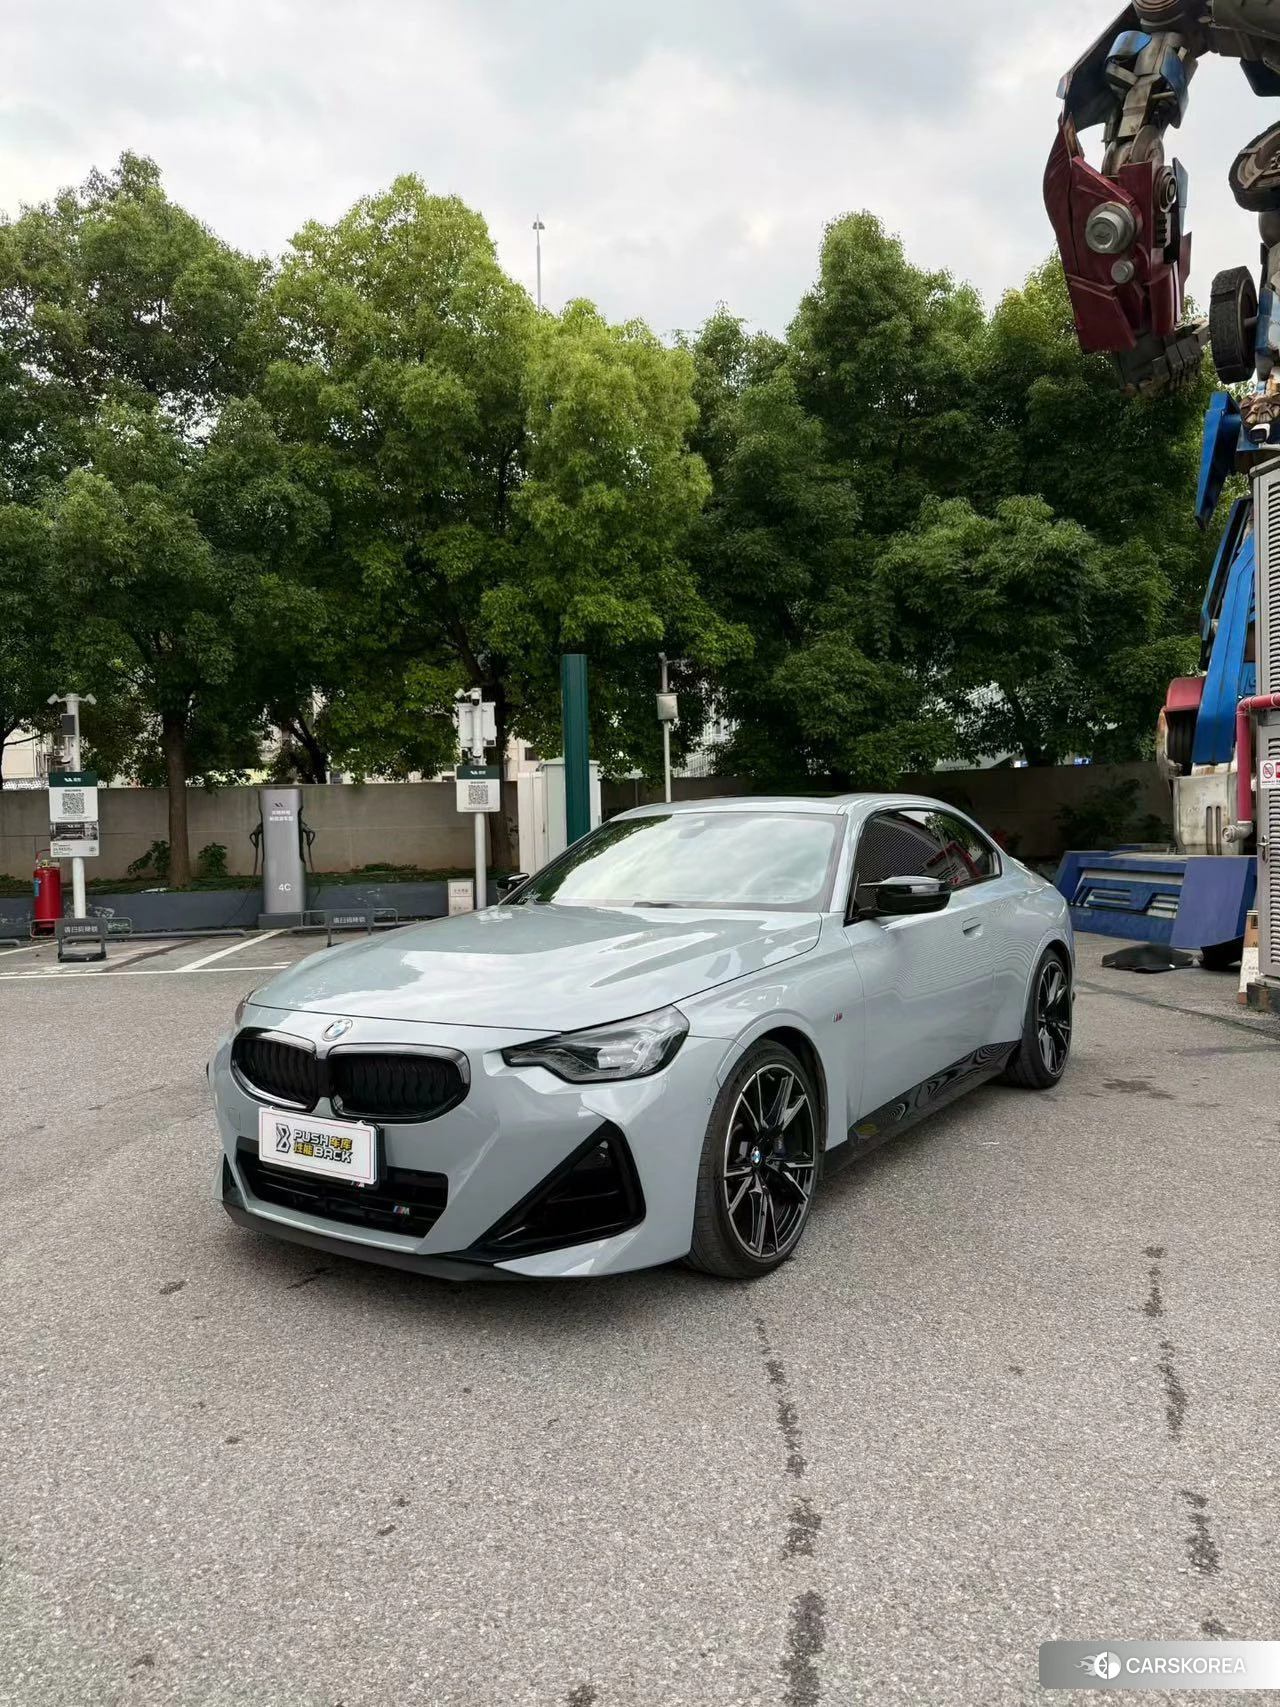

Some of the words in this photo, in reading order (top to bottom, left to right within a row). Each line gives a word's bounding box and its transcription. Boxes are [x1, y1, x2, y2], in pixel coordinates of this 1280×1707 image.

[278, 883, 291, 891] 4C
[293, 1129, 330, 1148] PUSH
[329, 1135, 353, 1151] 车库
[293, 1141, 314, 1157] 性能
[314, 1145, 353, 1164] BACK
